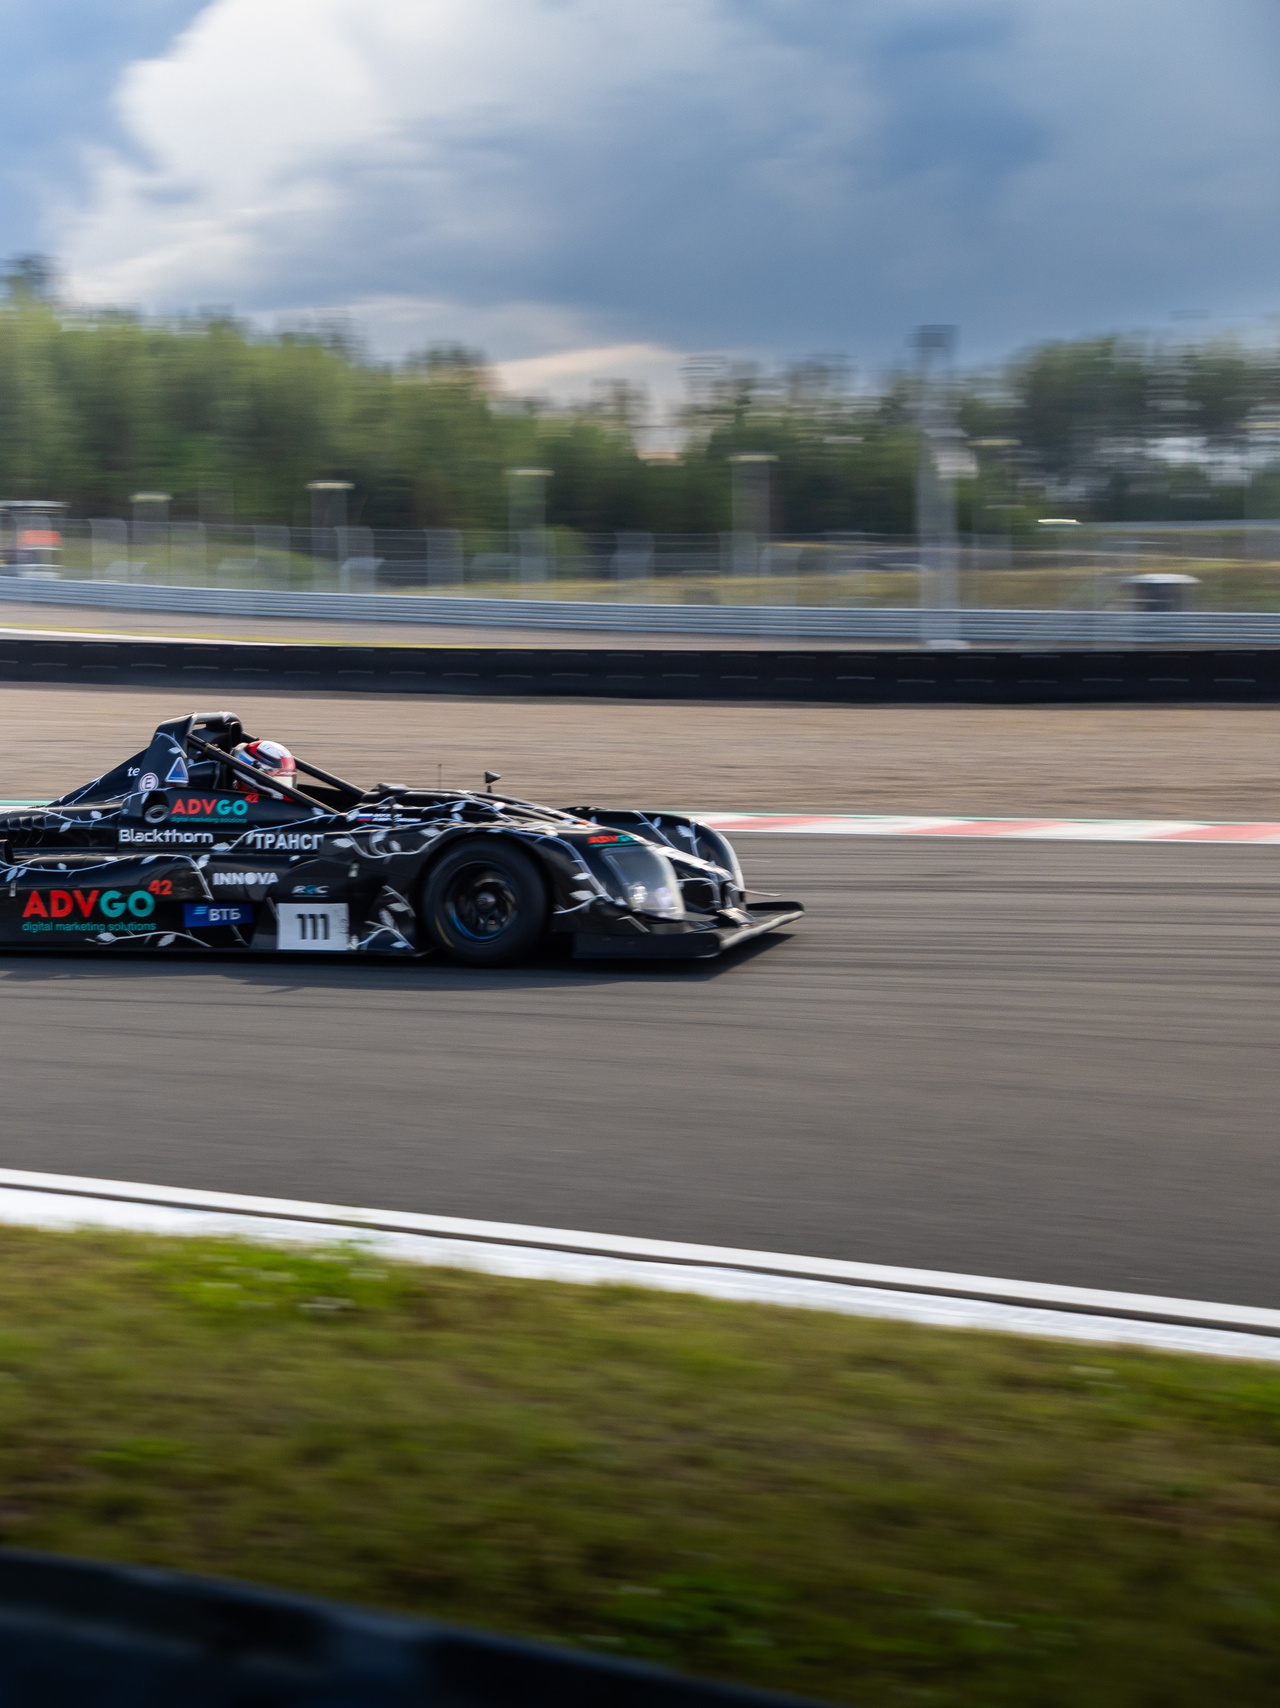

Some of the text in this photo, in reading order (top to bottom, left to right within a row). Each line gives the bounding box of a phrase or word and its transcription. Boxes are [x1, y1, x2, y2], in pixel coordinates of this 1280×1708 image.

[171, 798, 248, 816] ADVGO
[118, 828, 214, 844] Blackthorn
[212, 872, 279, 886] INNOVA
[22, 879, 173, 918] ADVGO 42
[208, 908, 242, 922] ВТБ
[22, 921, 157, 933] digital marketing solutions
[296, 913, 330, 941] 111
